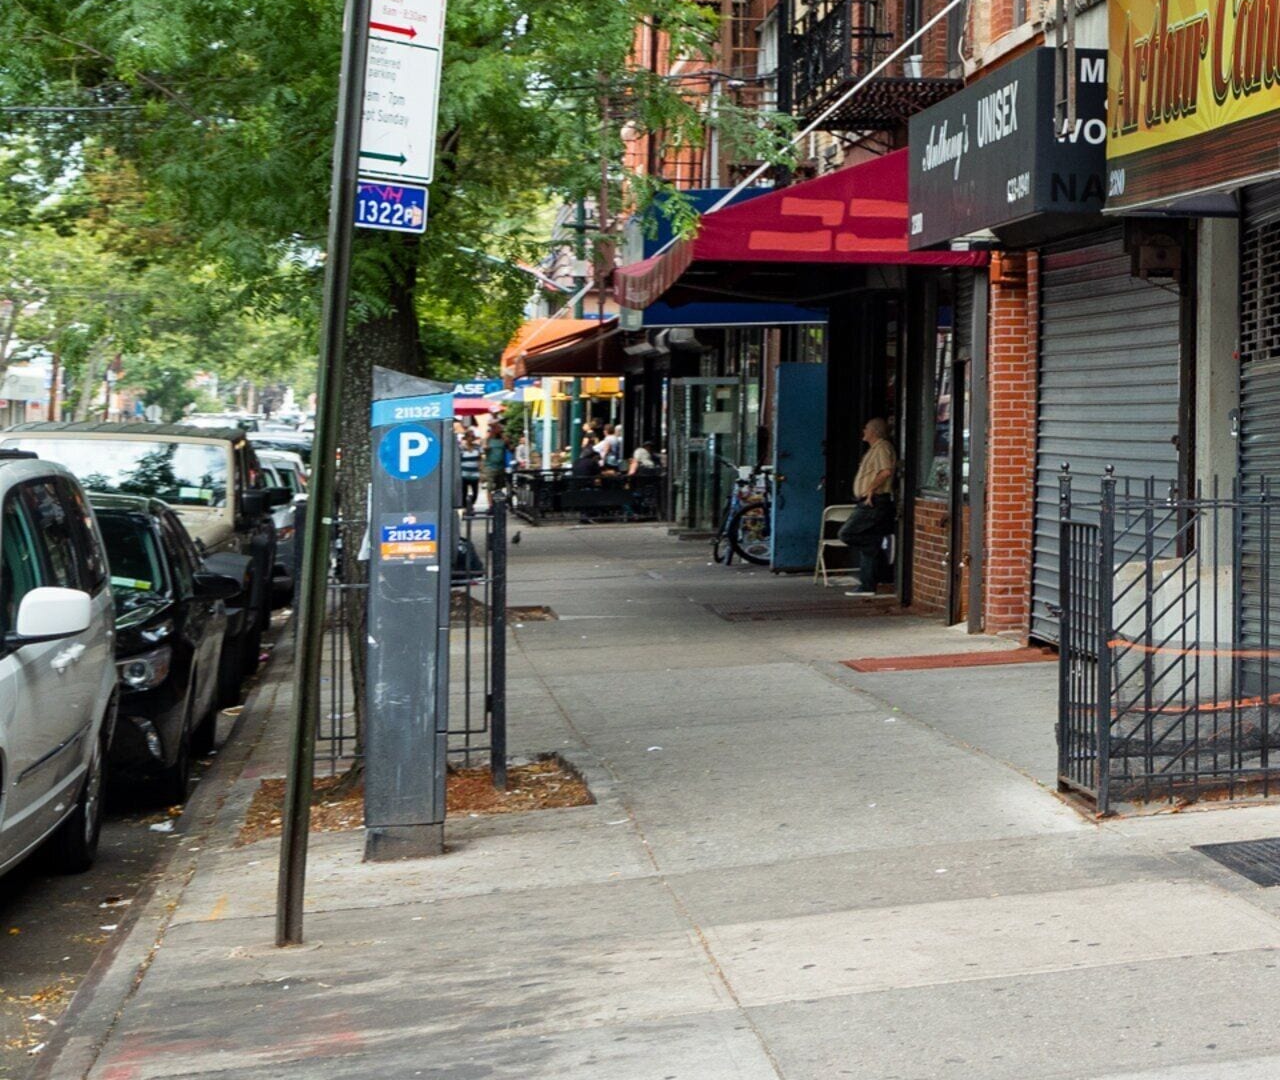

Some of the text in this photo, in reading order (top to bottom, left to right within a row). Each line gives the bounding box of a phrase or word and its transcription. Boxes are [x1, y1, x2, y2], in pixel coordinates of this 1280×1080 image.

[977, 80, 1018, 148] UNISEX
[358, 199, 404, 225] 1322
[453, 383, 485, 395] ASE
[394, 405, 441, 420] 211322
[399, 431, 429, 473] P
[388, 528, 432, 541] 211322
